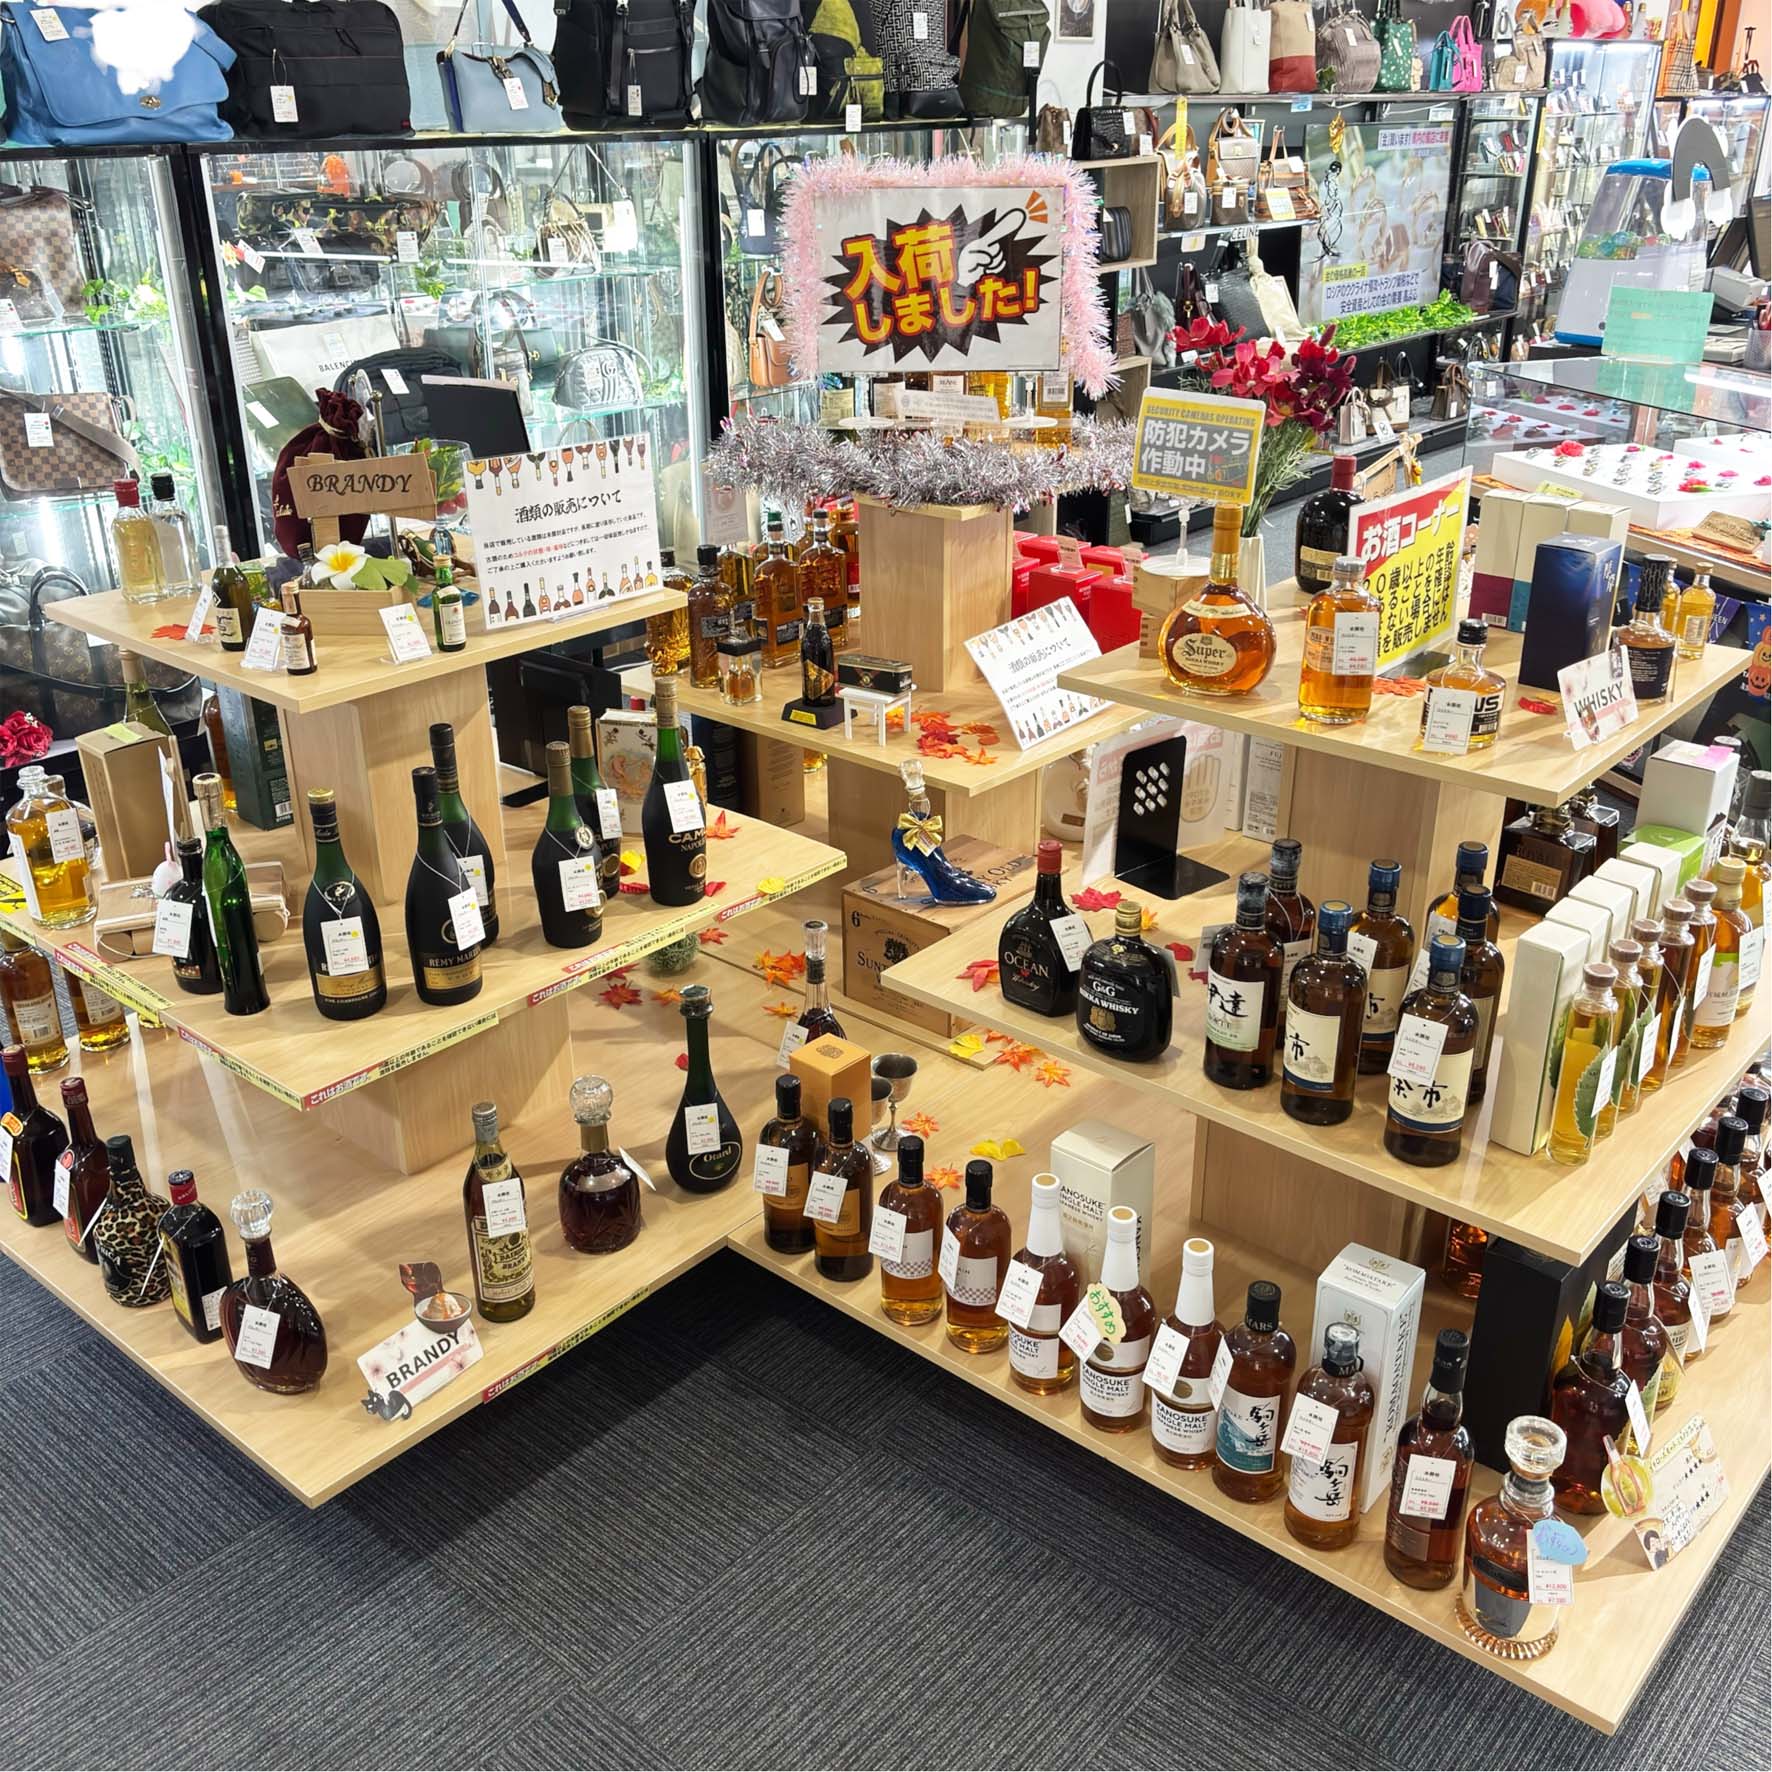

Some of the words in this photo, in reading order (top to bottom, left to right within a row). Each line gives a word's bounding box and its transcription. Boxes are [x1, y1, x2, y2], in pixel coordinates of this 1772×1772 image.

[1231, 225, 1260, 240] CELINE
[842, 223, 958, 299] 入荷
[852, 267, 1040, 345] しました!
[1146, 404, 1180, 418] SECURITY
[1181, 408, 1214, 423] CAMERAS
[1215, 412, 1257, 427] OPERATING
[1143, 418, 1251, 456] 防犯カメラ
[1140, 446, 1207, 480] 作動中
[305, 472, 415, 495] BRANDY
[514, 488, 623, 524] 酒類の販売について
[1362, 501, 1462, 562] お酒コーナー
[1181, 637, 1227, 660] Super
[1574, 681, 1626, 718] WHISKY
[668, 828, 706, 844] CAM
[851, 910, 861, 928] 6
[428, 955, 454, 968] REMY
[1004, 950, 1050, 978] OCEAN
[1092, 980, 1116, 997] G&G
[1099, 999, 1140, 1015] WHISKY
[702, 1145, 733, 1164] Otard
[1059, 1192, 1082, 1210] INGLE
[1082, 1201, 1104, 1217] MALT
[1059, 1200, 1082, 1215] APANESE
[1060, 1184, 1105, 1211] ANOSUKE
[1088, 1288, 1117, 1336] おすすめ
[1009, 1328, 1041, 1348] OSUKE
[1020, 1342, 1039, 1354] MALT
[384, 1328, 461, 1390] BRANDY
[1081, 1364, 1130, 1386] KANOSUKE
[1081, 1375, 1110, 1391] SINGLE
[1110, 1383, 1129, 1393] MALT
[1155, 1401, 1208, 1423] KANOSUKE
[1156, 1409, 1184, 1428] SINGLE
[1184, 1418, 1207, 1430] MALT
